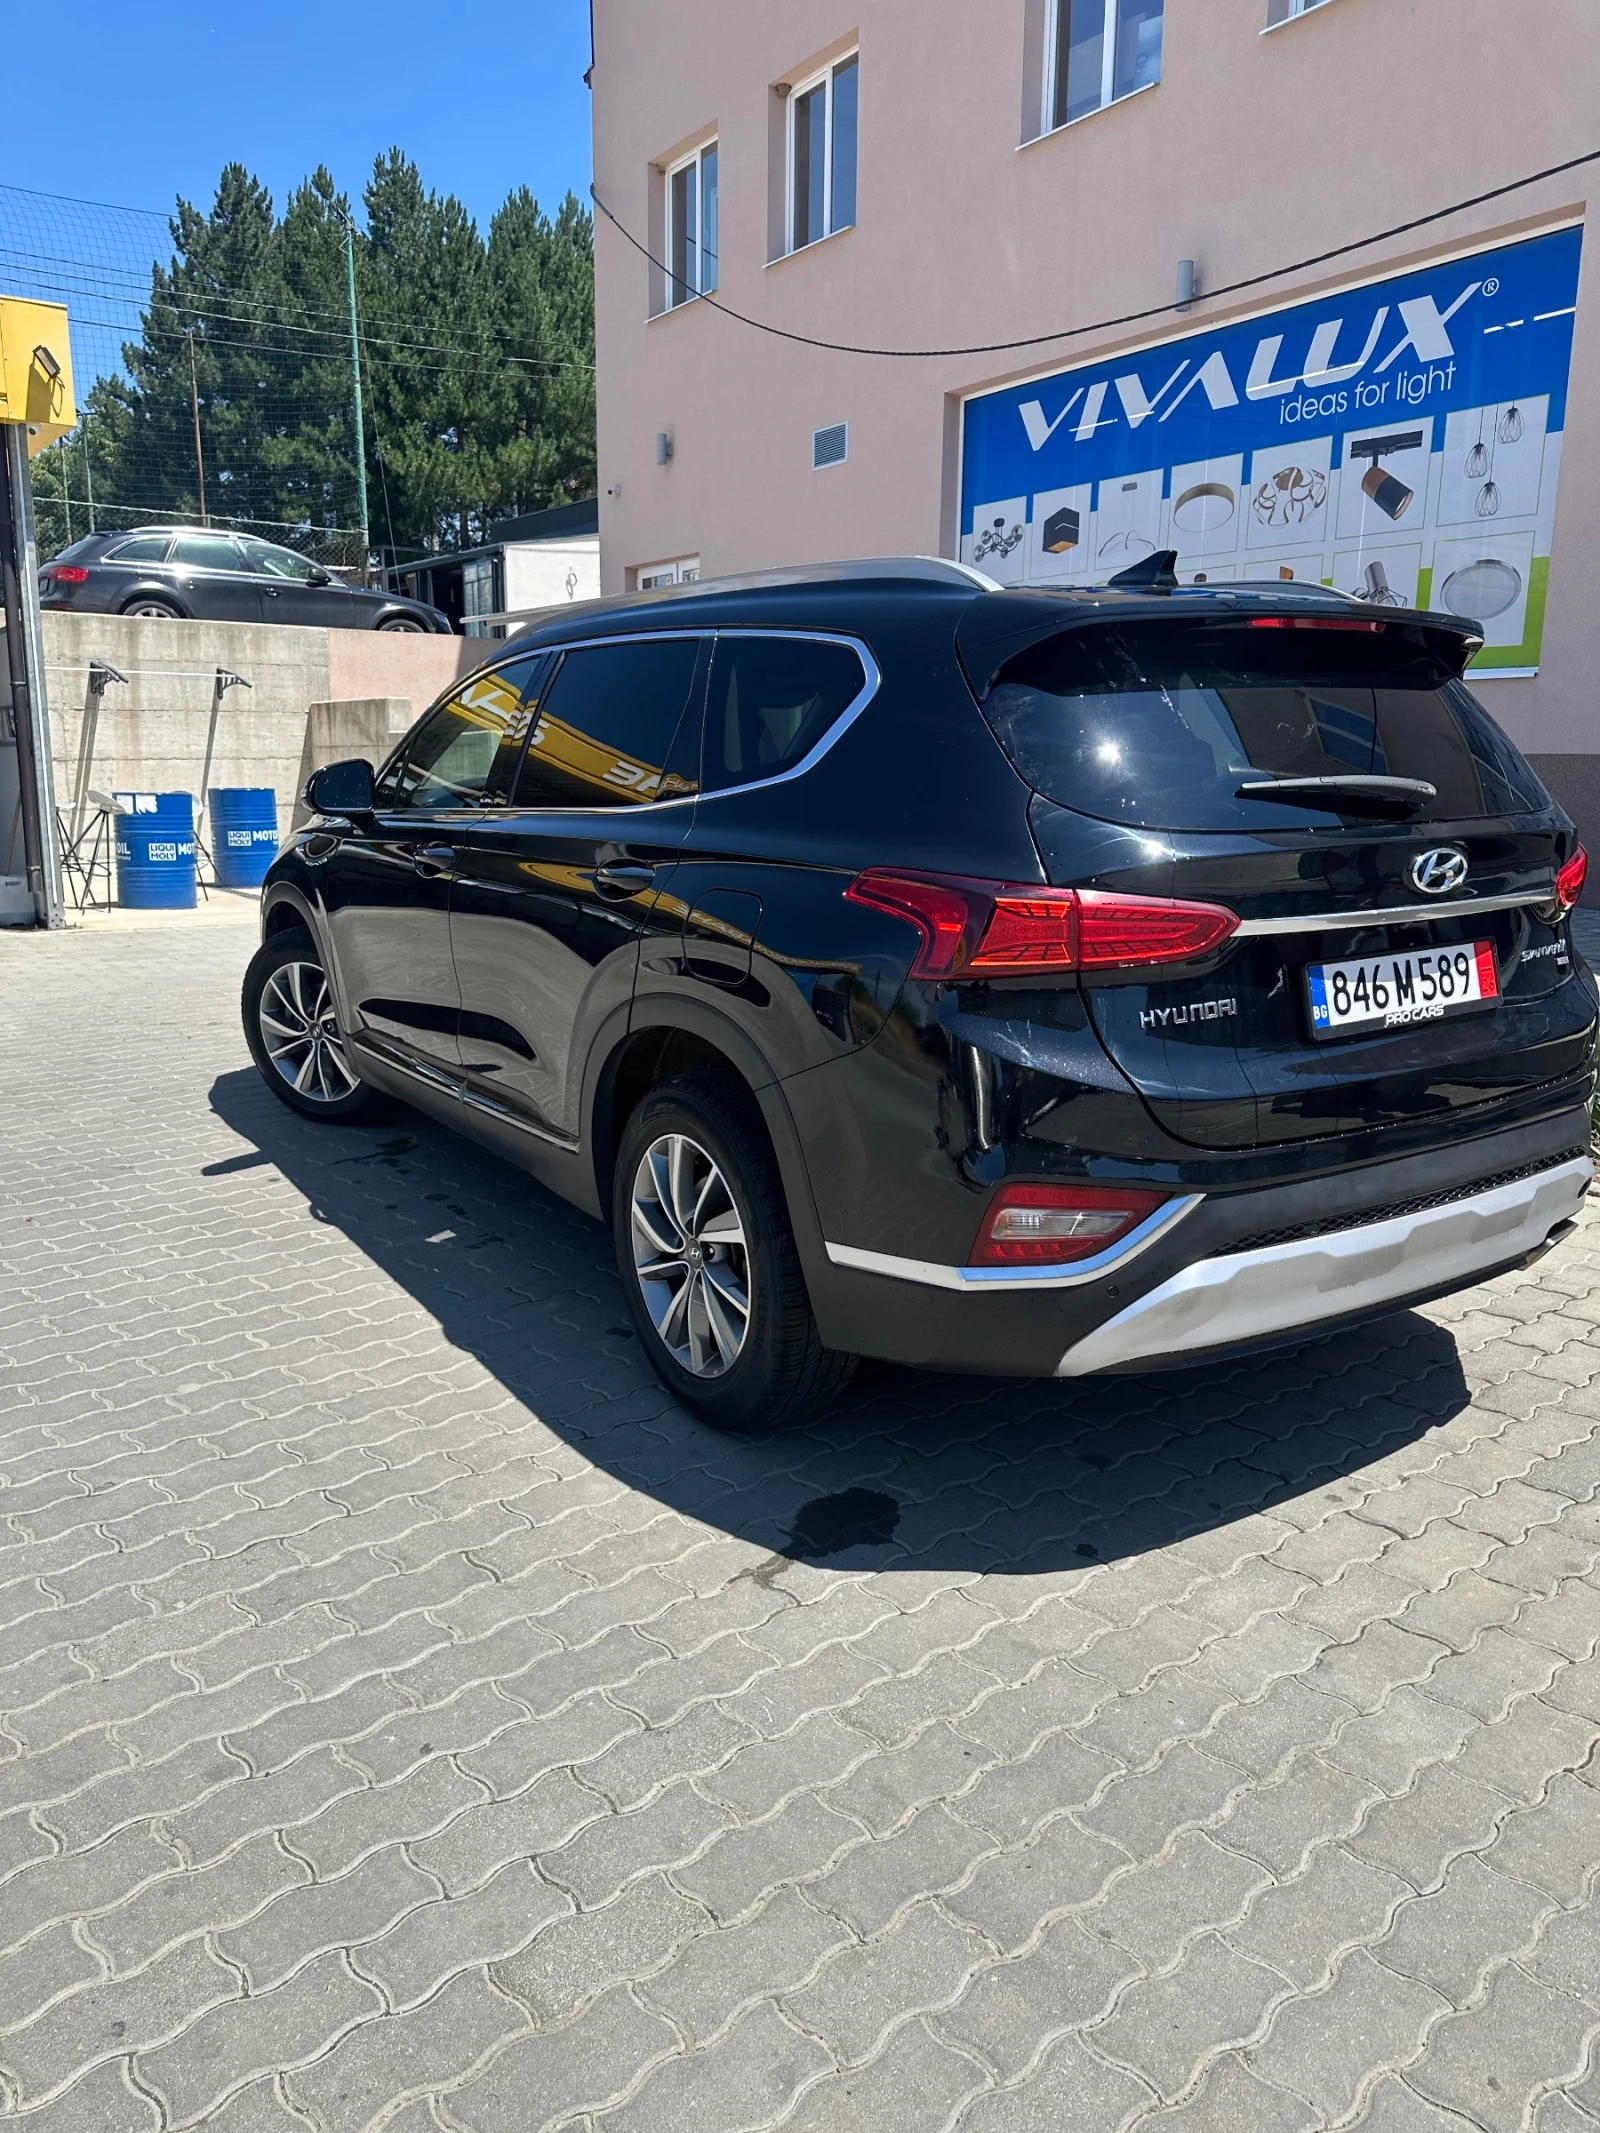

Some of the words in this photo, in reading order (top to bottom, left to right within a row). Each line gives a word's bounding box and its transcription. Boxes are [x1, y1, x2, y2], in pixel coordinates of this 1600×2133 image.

[1018, 281, 1483, 452] VIVALUX
[1279, 390, 1348, 425] ideas
[1354, 378, 1391, 408] for
[1396, 362, 1457, 405] light
[116, 842, 131, 855] OIL
[151, 852, 175, 860] MOLY
[1139, 998, 1238, 1028] HYUNDAI
[1313, 1005, 1328, 1020] BG
